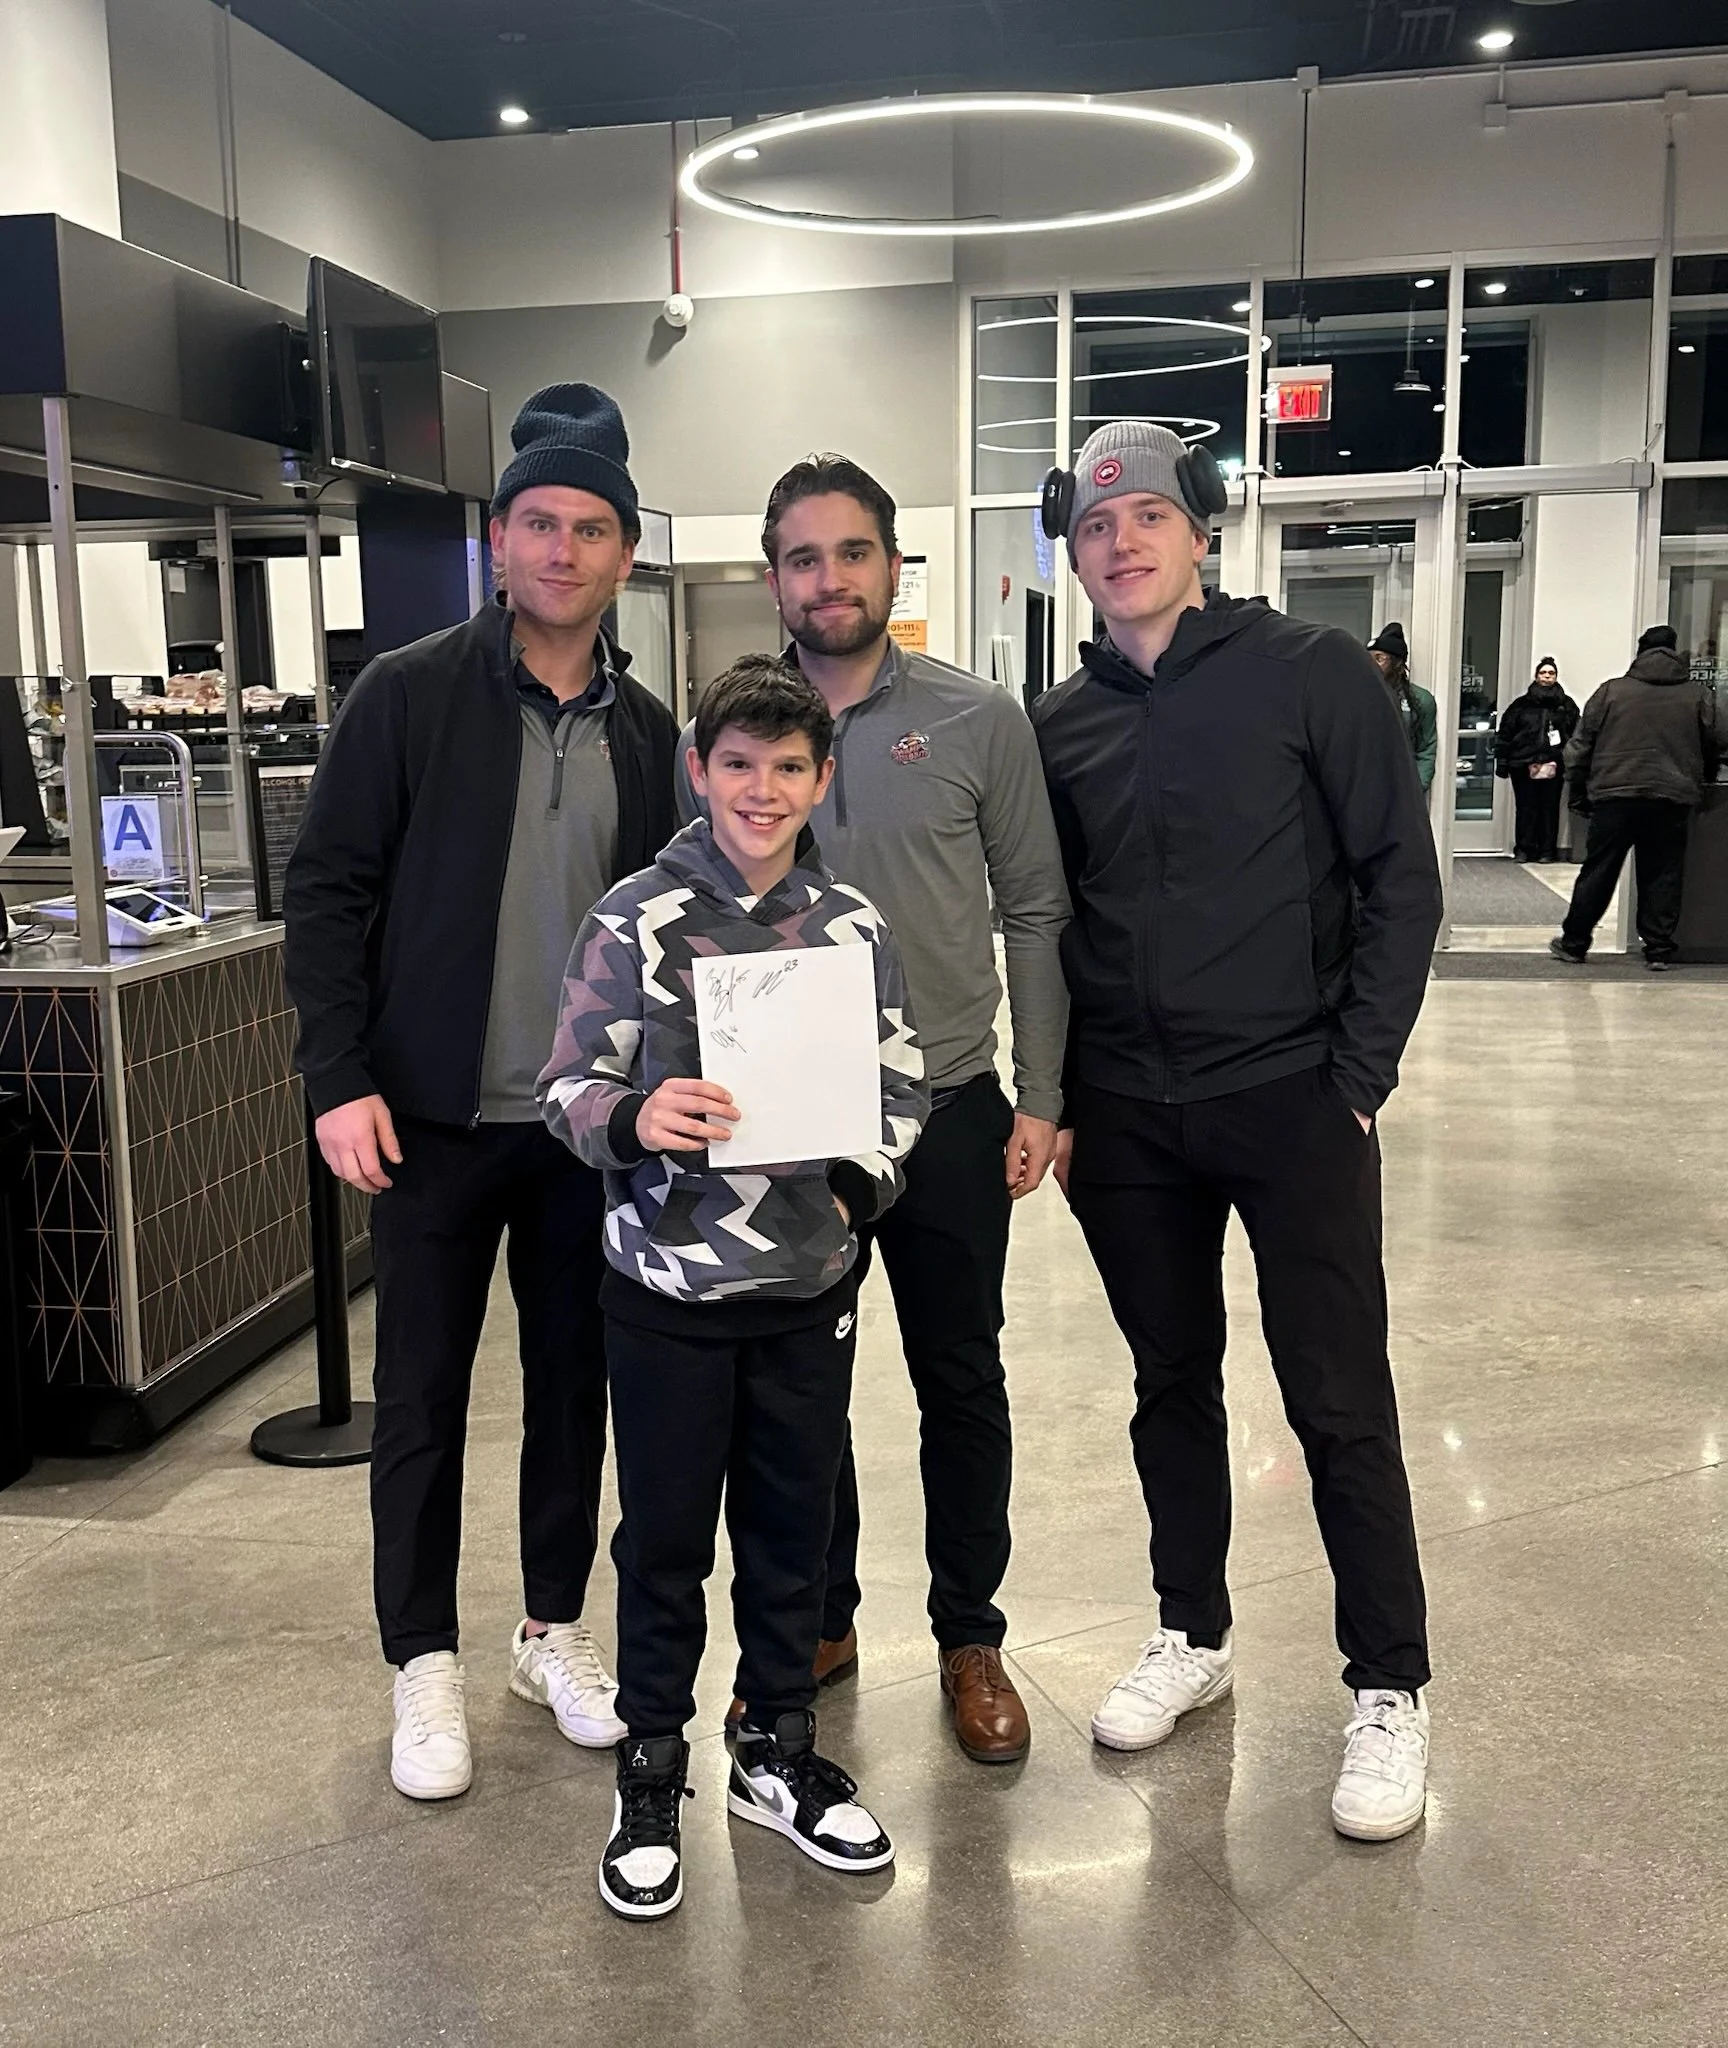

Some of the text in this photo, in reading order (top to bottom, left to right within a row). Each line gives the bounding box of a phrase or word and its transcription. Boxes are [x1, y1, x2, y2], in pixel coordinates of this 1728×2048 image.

[1279, 385, 1322, 419] EXIT
[113, 804, 153, 850] A
[783, 958, 799, 972] 23
